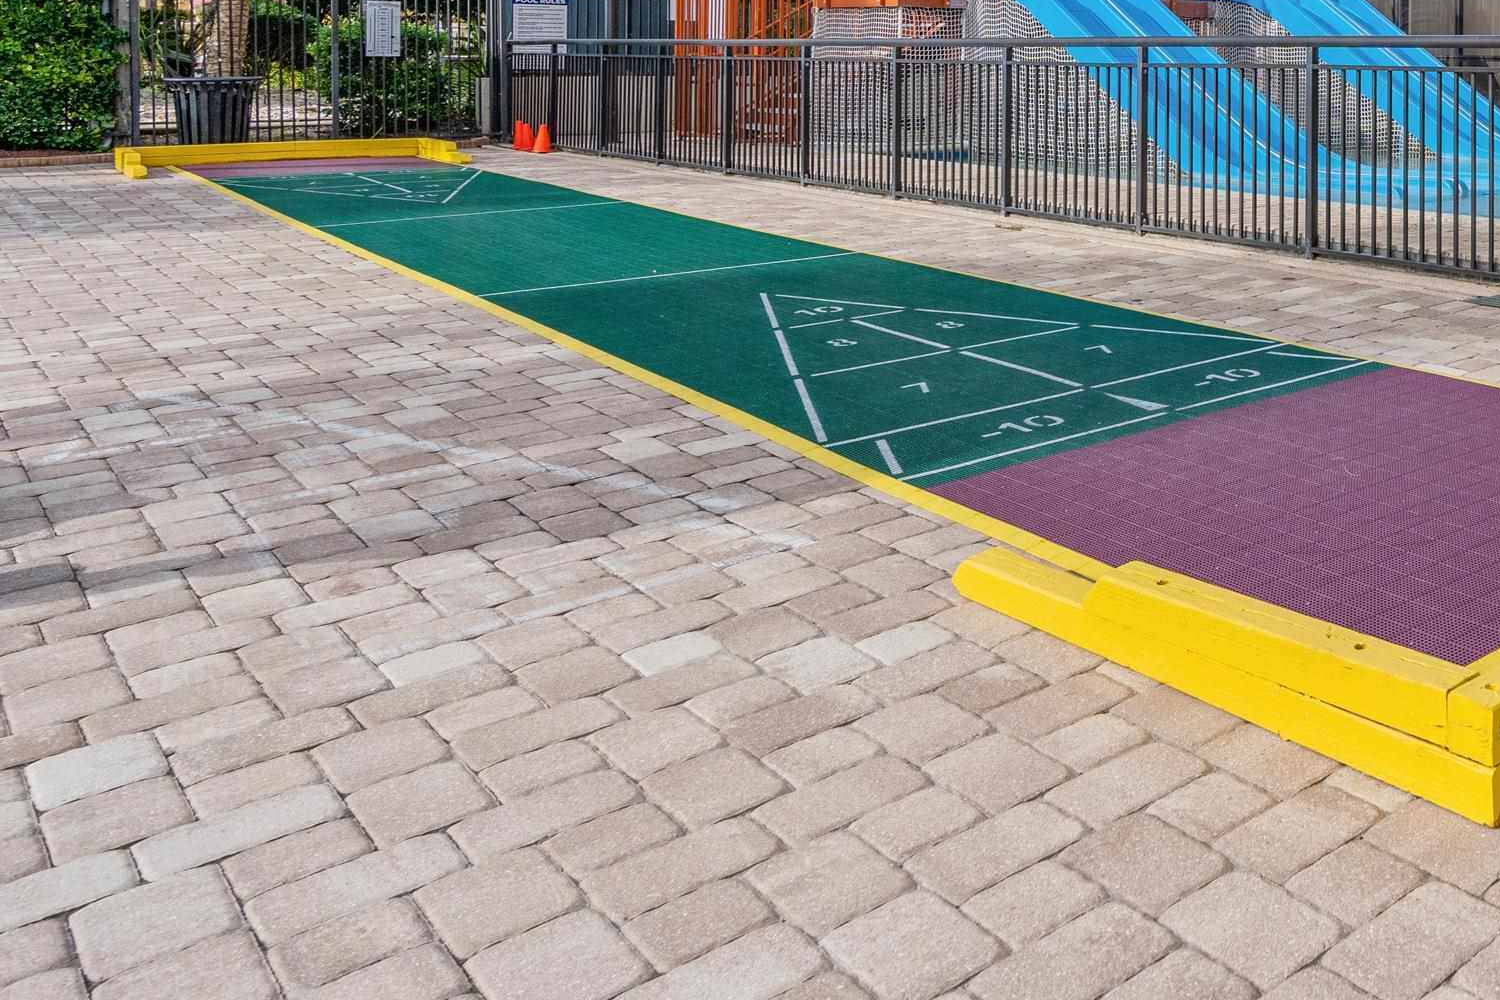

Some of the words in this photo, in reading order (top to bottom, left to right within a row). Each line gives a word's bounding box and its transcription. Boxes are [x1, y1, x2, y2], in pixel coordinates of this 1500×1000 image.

[794, 305, 845, 317] 10
[935, 320, 966, 330] 8
[826, 337, 858, 348] 8
[1083, 344, 1113, 355] 7
[1193, 368, 1262, 387] -10
[900, 381, 930, 394] 7
[981, 415, 1065, 438] -10
